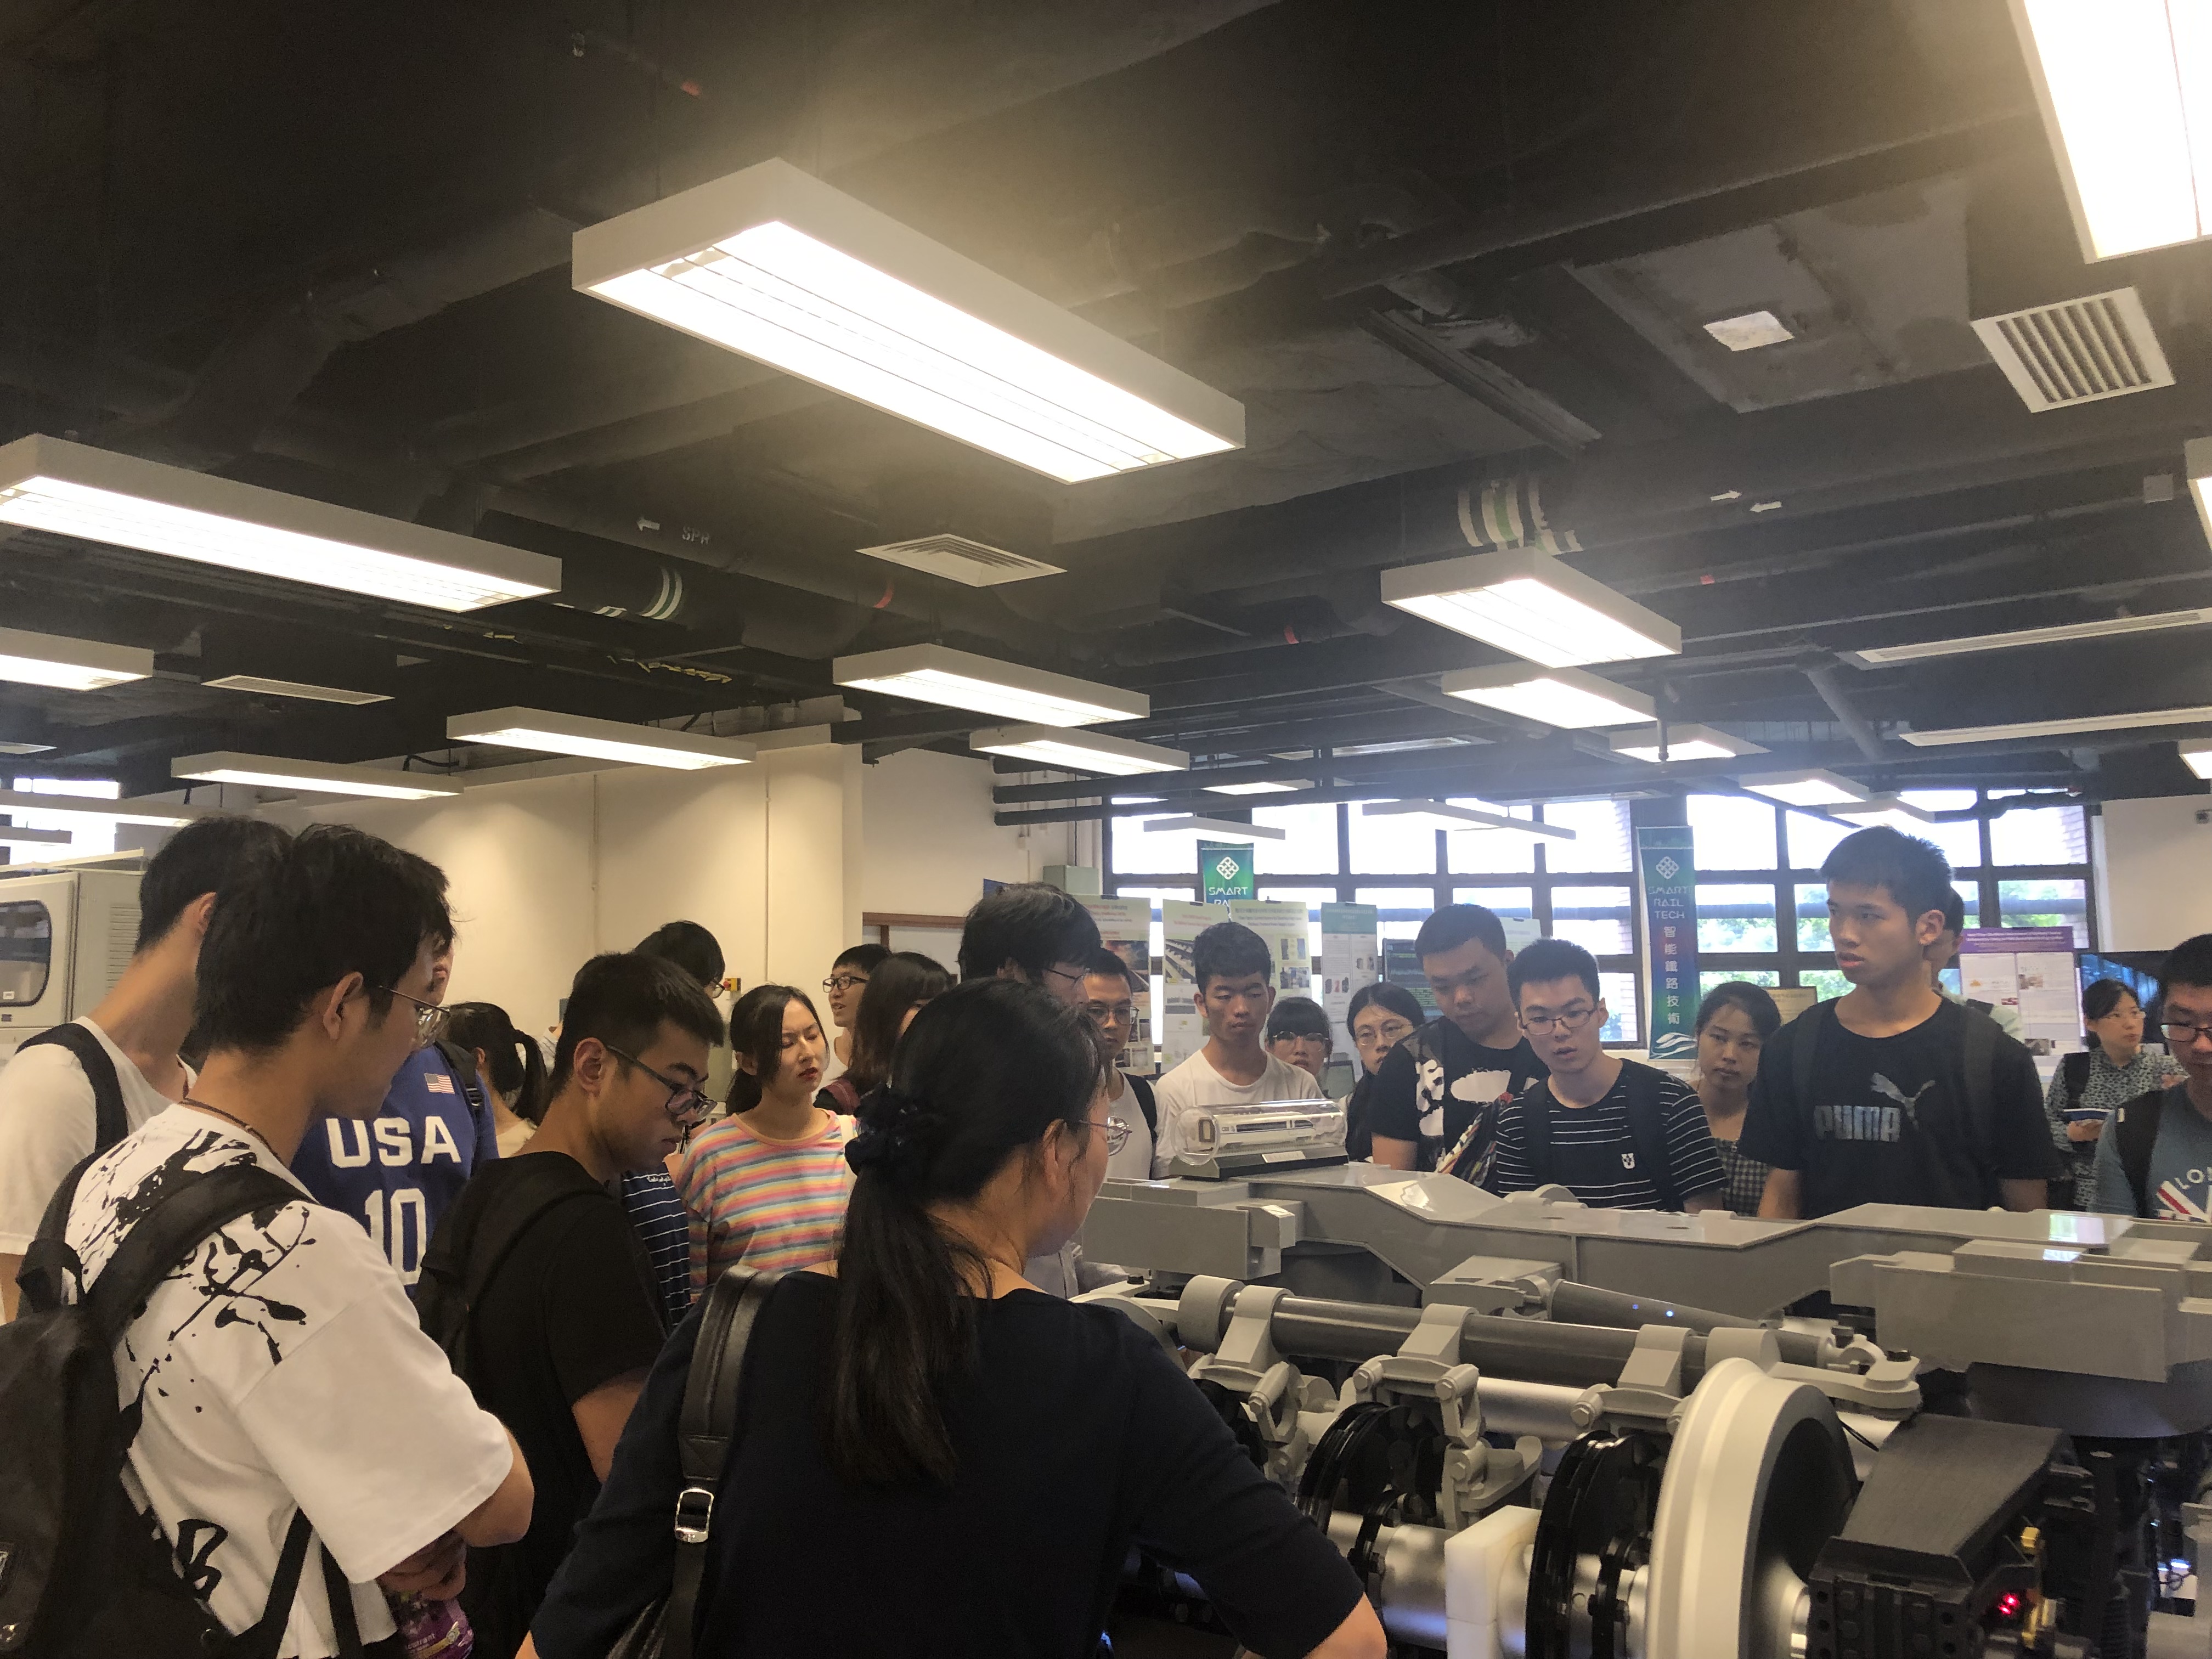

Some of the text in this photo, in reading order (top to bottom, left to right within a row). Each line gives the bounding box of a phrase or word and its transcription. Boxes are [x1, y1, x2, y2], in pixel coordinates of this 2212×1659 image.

[1208, 887, 1249, 895] SMART
[1647, 885, 1688, 895] SMART
[1654, 898, 1684, 906] RAIL
[1654, 910, 1685, 919] TECH
[1813, 1105, 1901, 1143] PUMA
[326, 1115, 462, 1169] USA
[365, 1188, 427, 1286] 10
